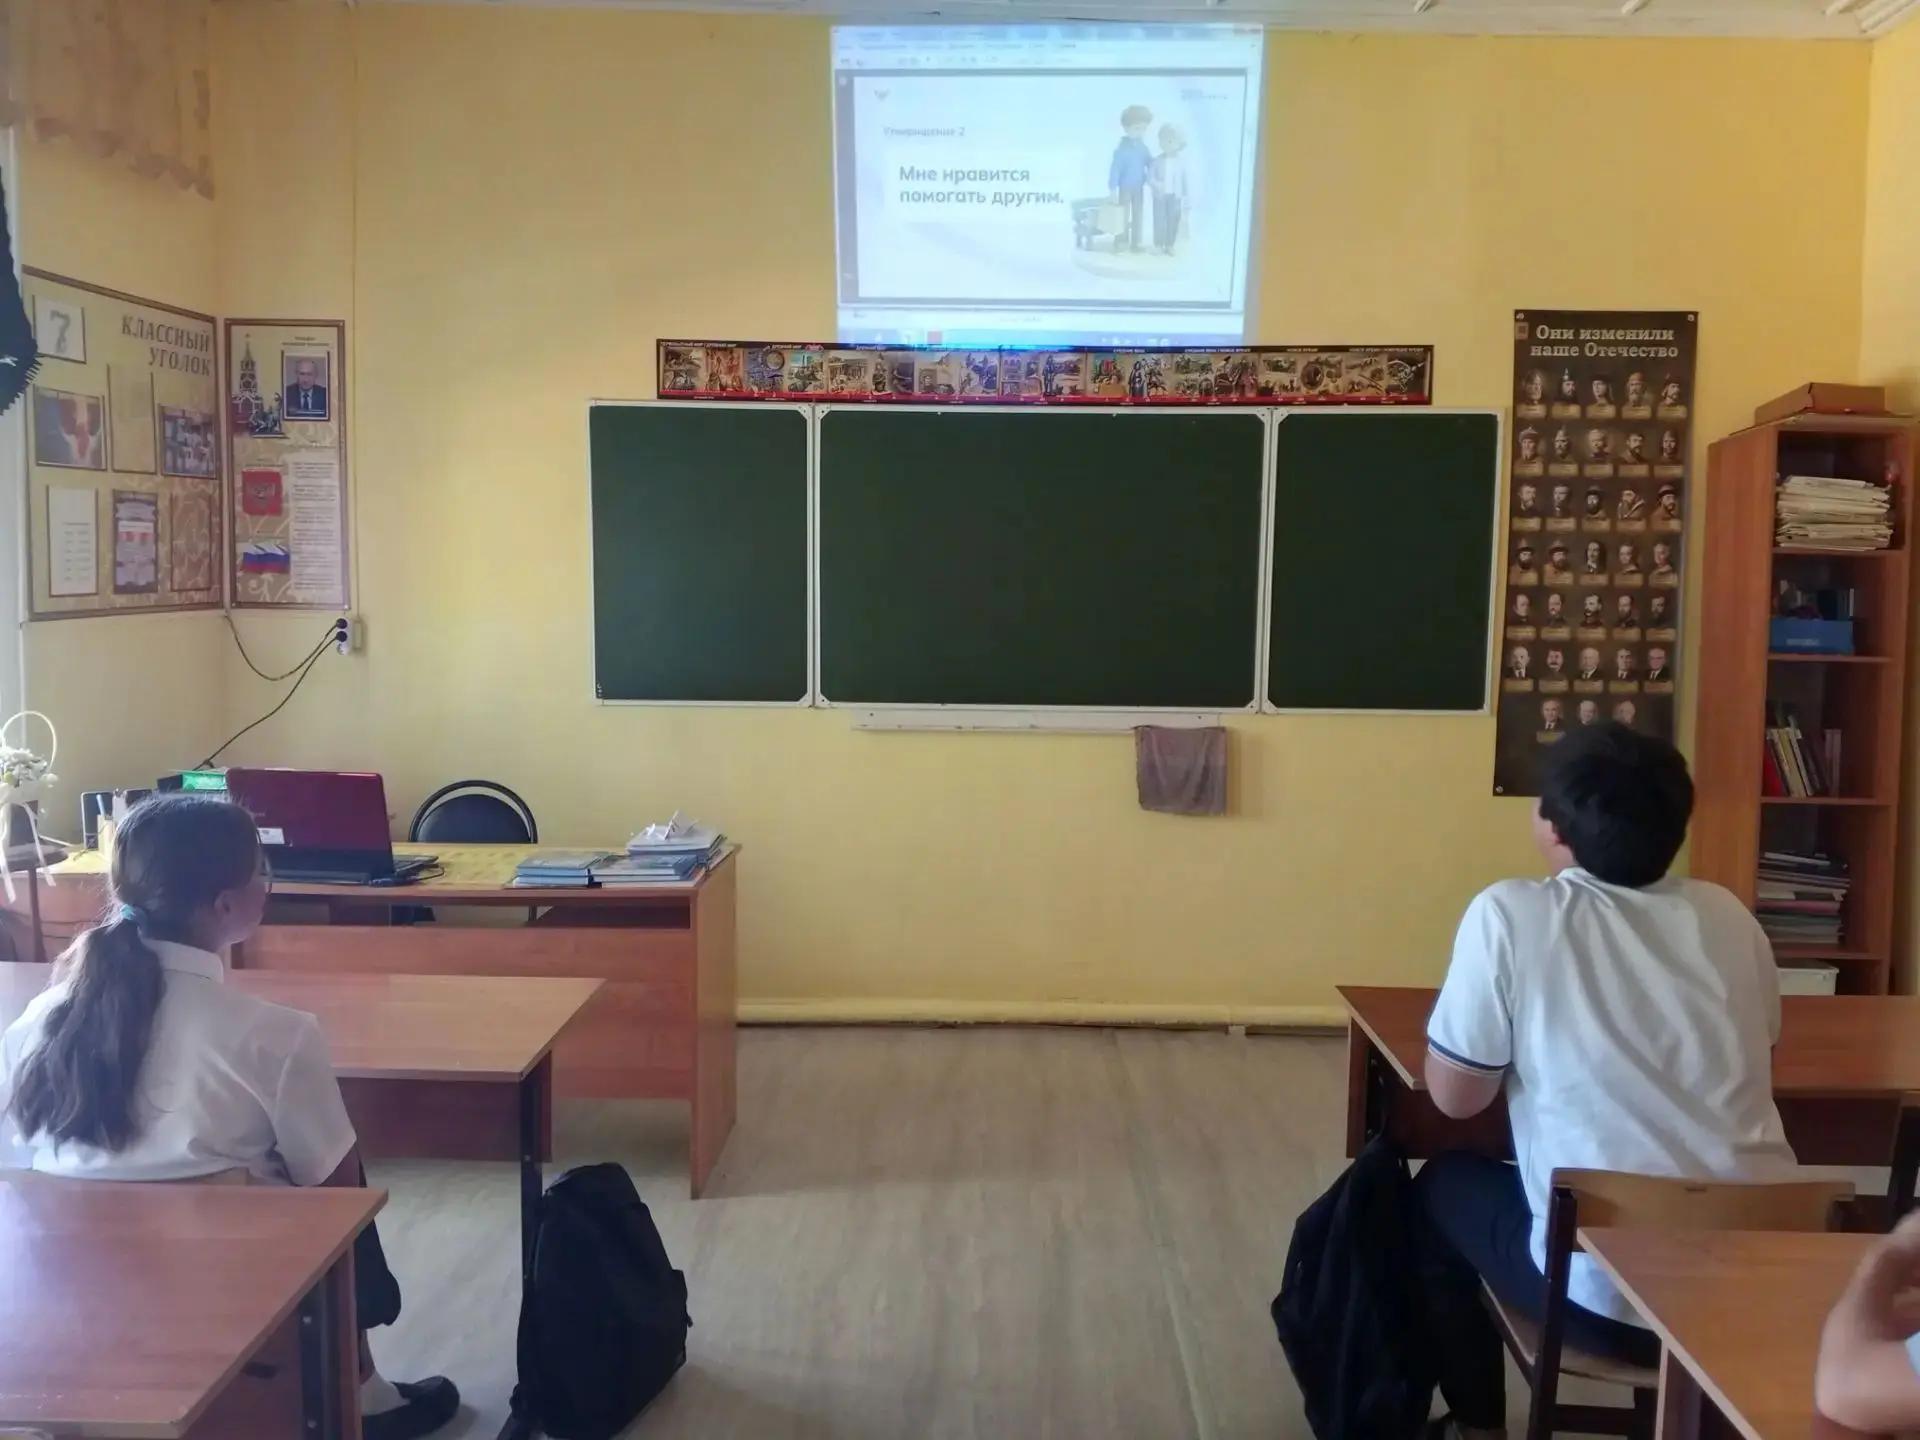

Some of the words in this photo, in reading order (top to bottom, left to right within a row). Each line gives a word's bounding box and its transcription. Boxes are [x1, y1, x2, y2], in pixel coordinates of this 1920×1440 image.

[958, 126, 966, 138] 2
[899, 166, 938, 182] Мне
[941, 168, 1030, 185] нравится
[899, 189, 986, 205] помогать
[991, 190, 1065, 208] другим.
[49, 309, 73, 355] 7
[121, 314, 211, 353] КЛАССНЫЙ
[1535, 324, 1576, 341] Они
[1578, 327, 1676, 342] изменили
[1529, 344, 1580, 358] наше
[1583, 342, 1680, 360] Отечество
[147, 346, 213, 377] УГОЛОК
